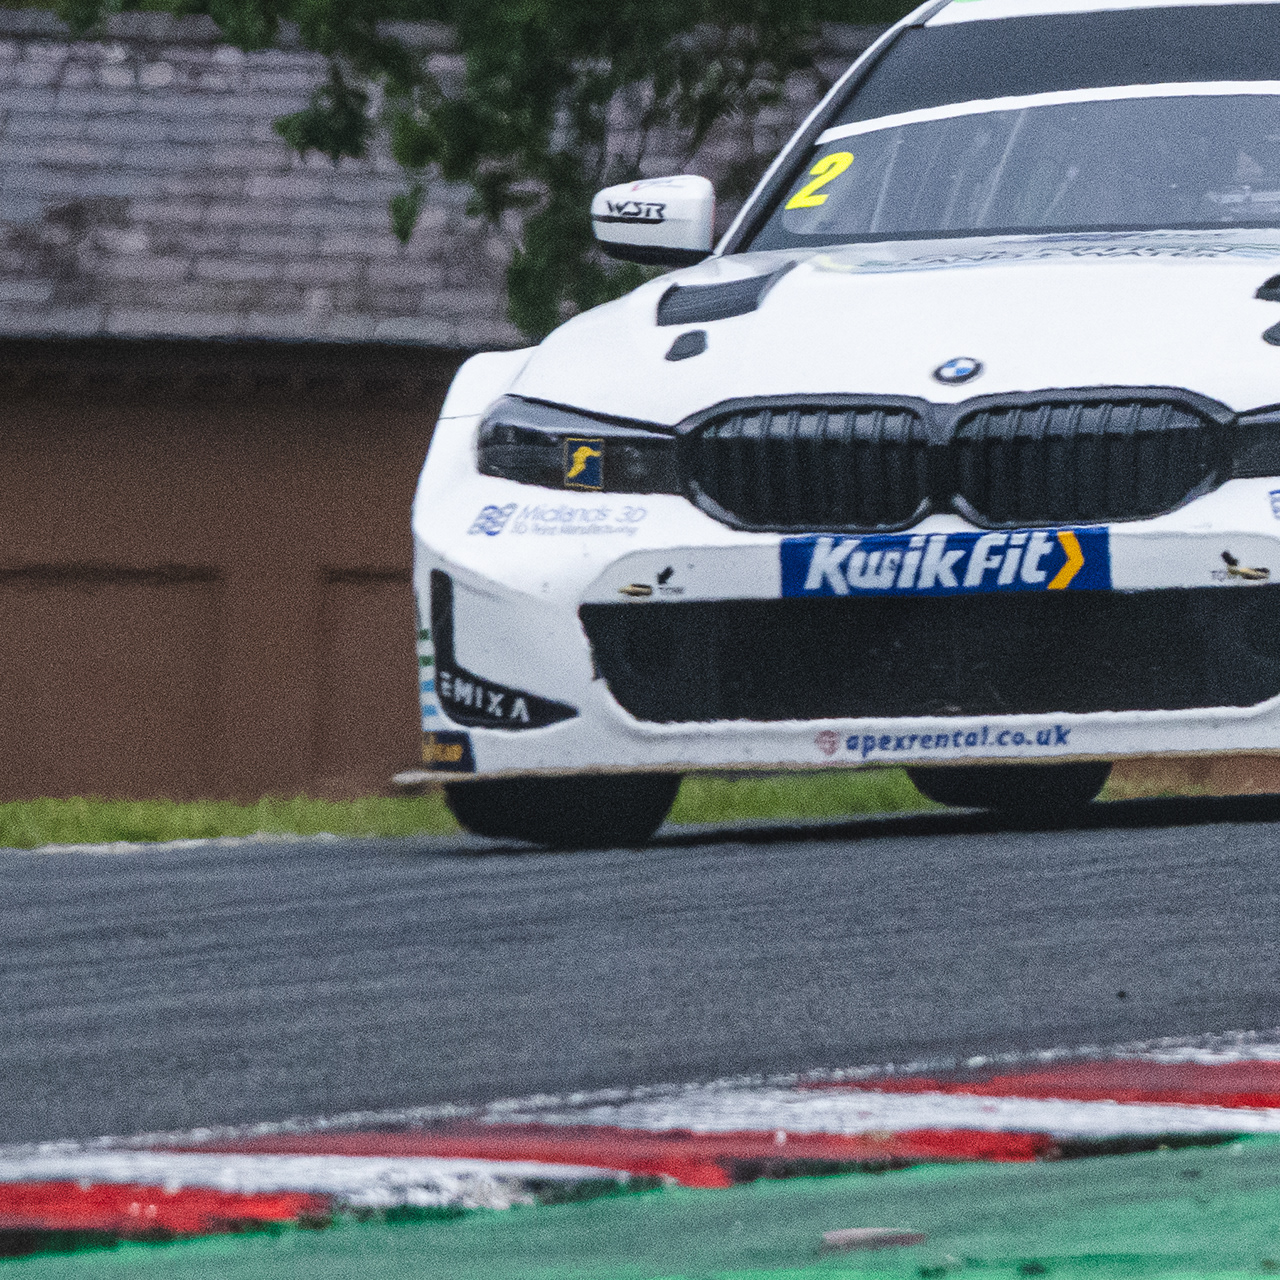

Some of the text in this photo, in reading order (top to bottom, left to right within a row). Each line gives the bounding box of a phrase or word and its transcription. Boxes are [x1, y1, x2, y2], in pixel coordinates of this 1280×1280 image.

[785, 151, 854, 210] 2
[606, 200, 668, 219] WSR
[441, 670, 530, 723] EMIXA
[846, 724, 1072, 758] apexrental.co.uk
